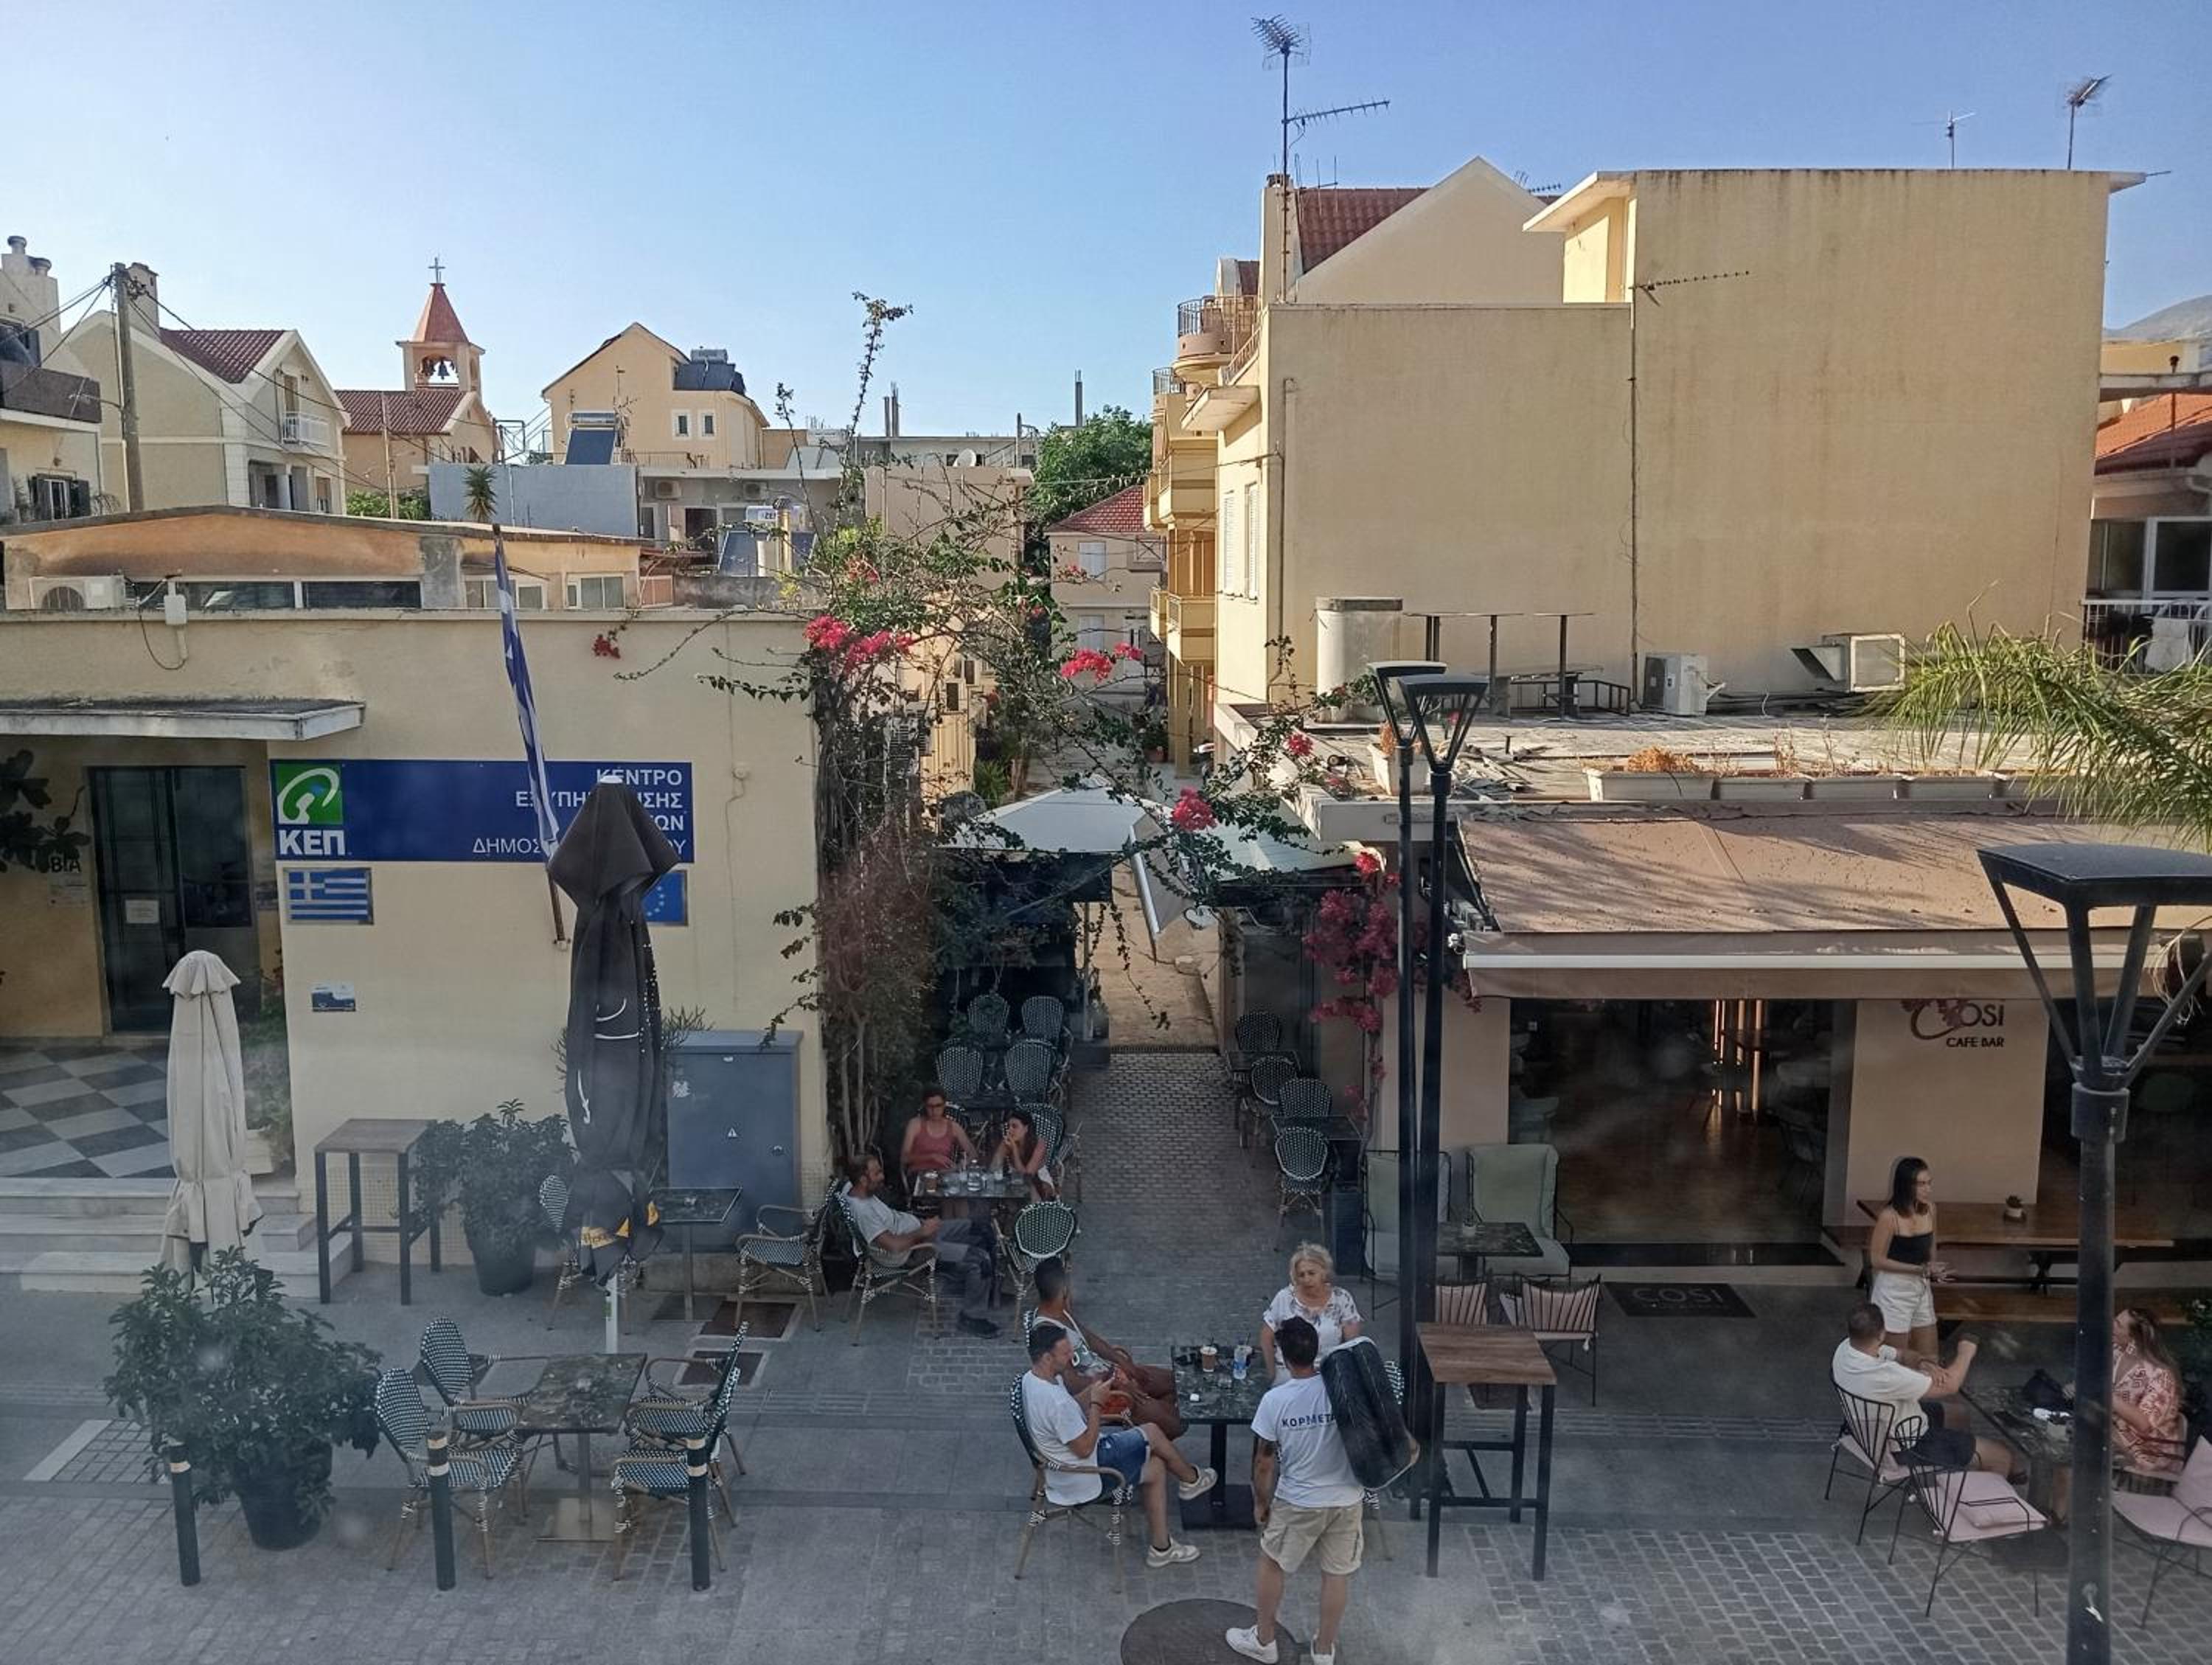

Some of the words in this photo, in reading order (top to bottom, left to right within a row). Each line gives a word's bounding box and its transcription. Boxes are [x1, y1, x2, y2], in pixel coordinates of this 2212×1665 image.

[279, 830, 345, 855] ΚΕΠ
[473, 838, 541, 853] ΔΗΜΟΣ
[1947, 1037, 1979, 1048] CAFE
[1981, 1037, 2005, 1048] BAR
[1632, 1287, 1723, 1304] COSI
